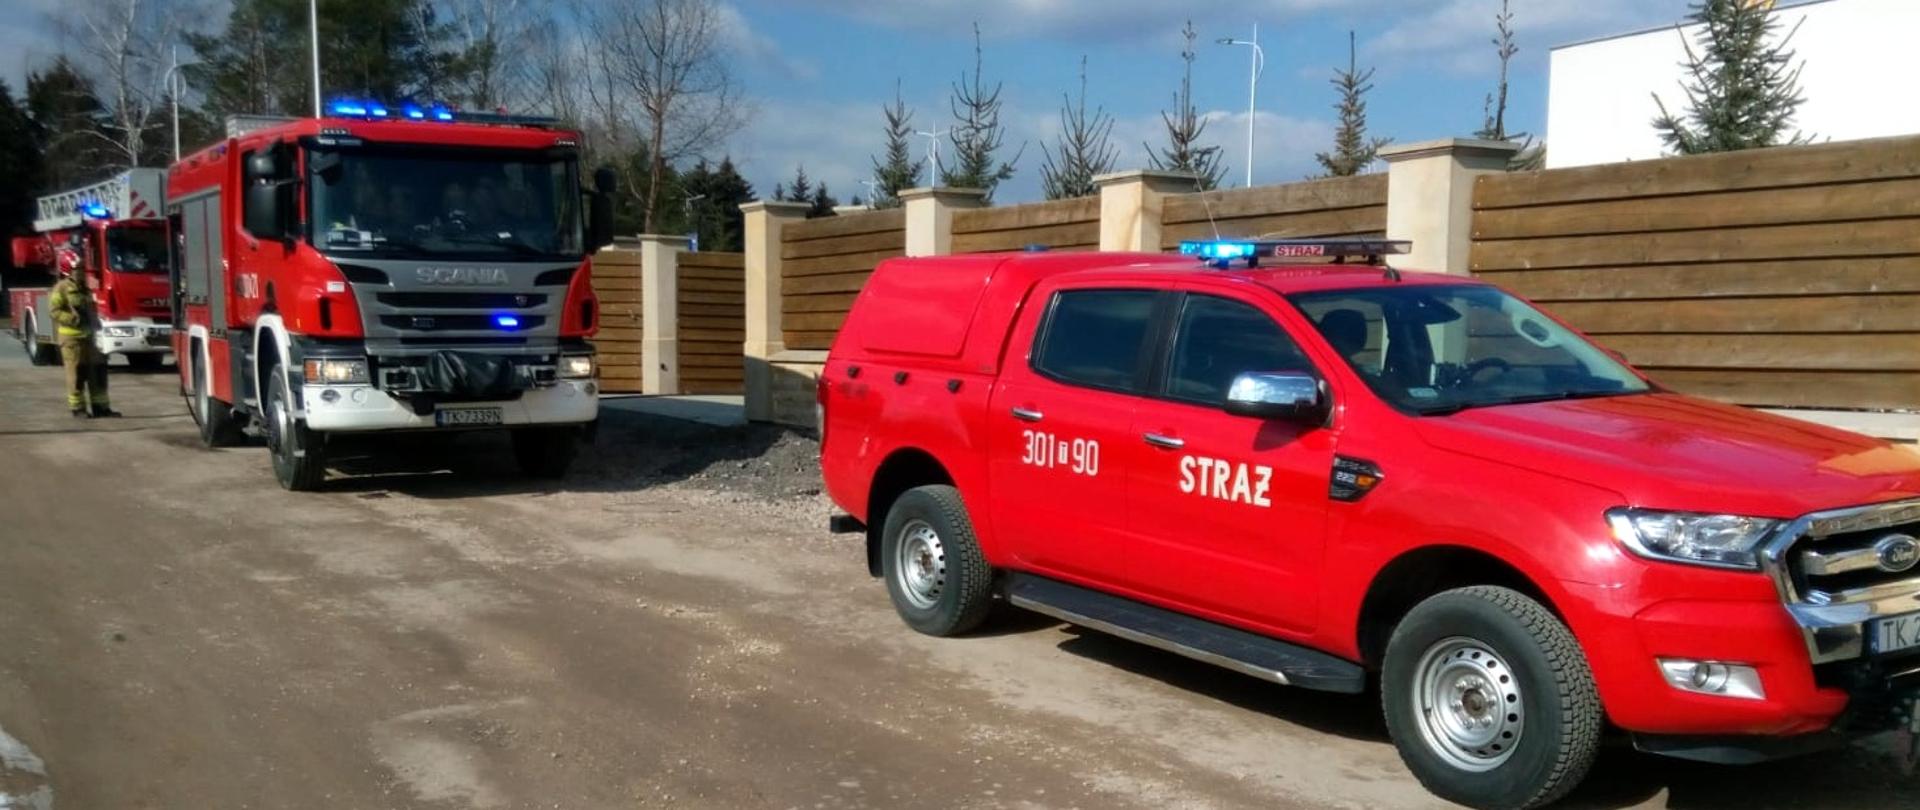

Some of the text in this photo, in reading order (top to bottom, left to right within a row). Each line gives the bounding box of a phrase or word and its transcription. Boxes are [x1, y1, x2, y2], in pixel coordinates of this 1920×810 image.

[416, 267, 510, 284] SCANIA
[1022, 430, 1055, 468] 301
[1072, 438, 1099, 476] 90
[1883, 619, 1907, 650] TK
